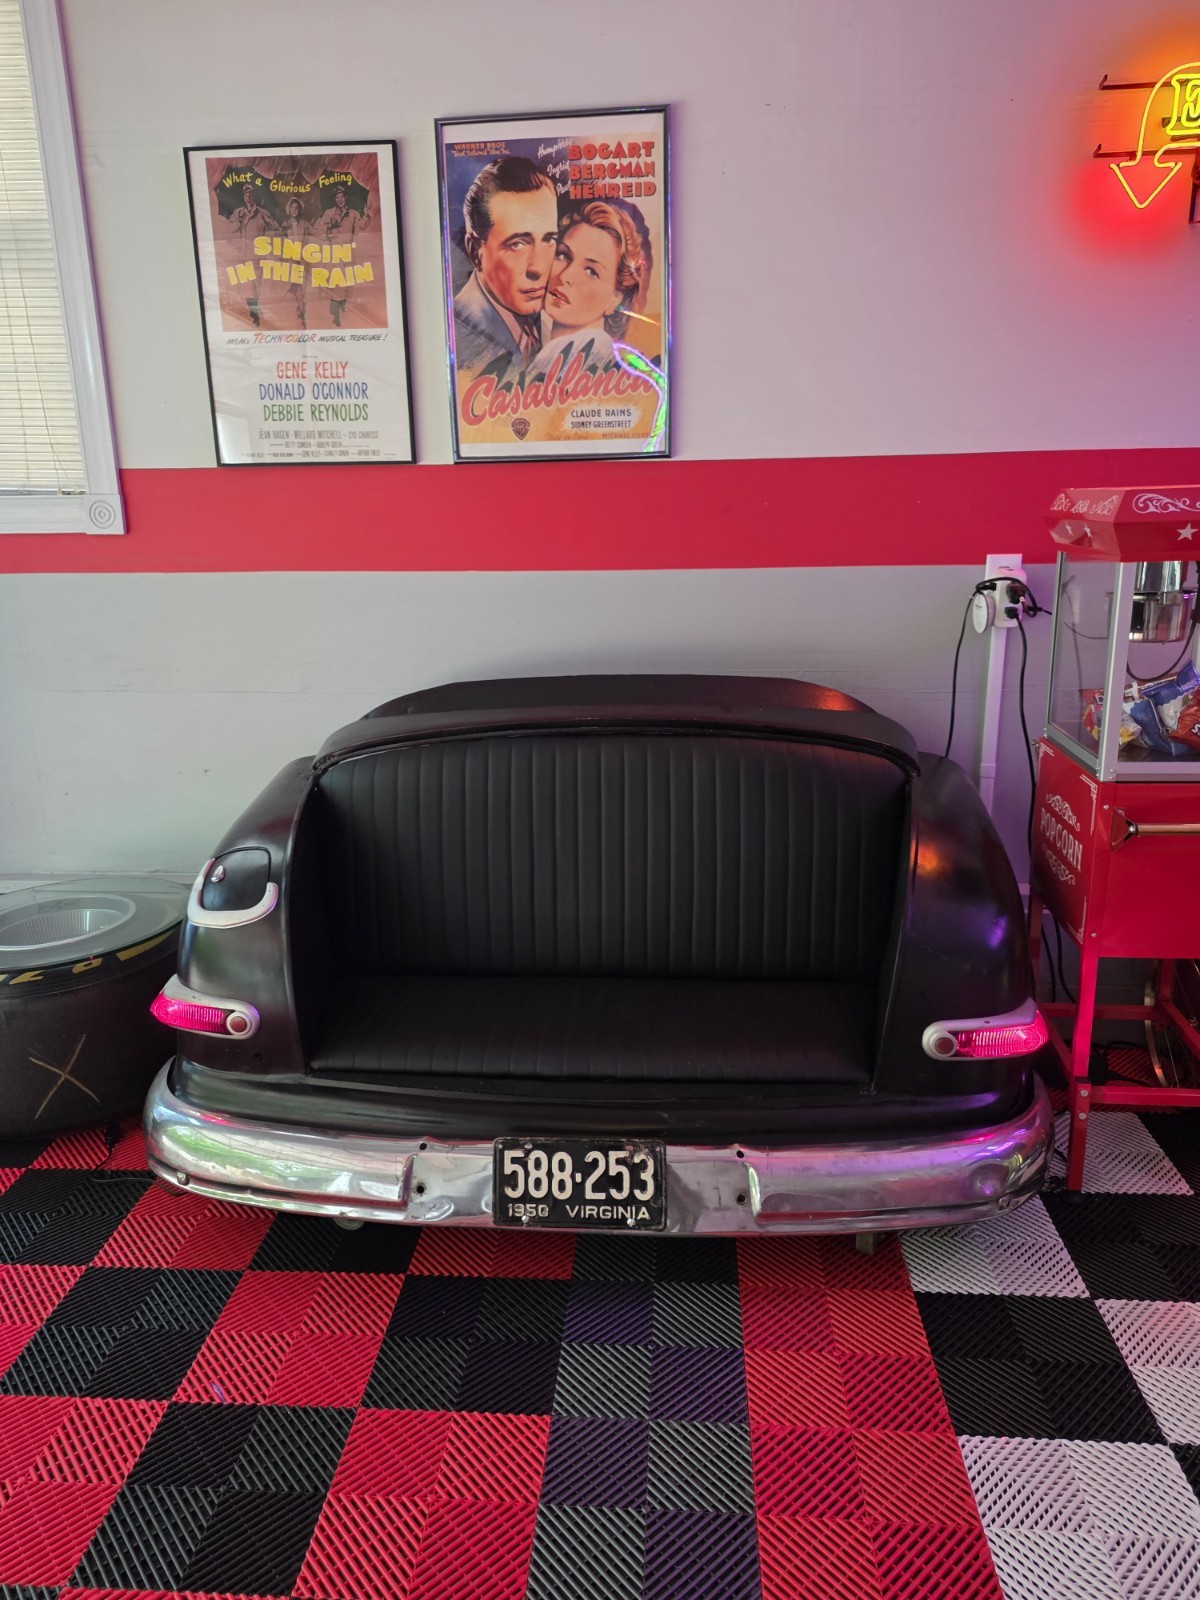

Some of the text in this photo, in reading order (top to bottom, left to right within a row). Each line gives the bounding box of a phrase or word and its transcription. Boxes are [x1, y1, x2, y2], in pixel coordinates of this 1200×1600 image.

[453, 143, 485, 151] WARNER
[567, 141, 655, 161] BOGART
[547, 160, 570, 179] Ingrid
[568, 160, 656, 181] BERGMAN
[222, 172, 353, 193] What a Glorious Feeling
[569, 181, 657, 200] HENREID
[253, 236, 357, 264] SINGIN'
[226, 260, 374, 289] IN THE RAIN
[253, 333, 317, 344] TECHNICOLOR
[318, 334, 347, 343] MUSICAL
[276, 360, 349, 380] GENE KELLY
[259, 382, 369, 401] DONALD O'CONNOR
[461, 351, 655, 427] Casablanca
[263, 403, 369, 422] DEBBIE REYNOLDS
[571, 408, 632, 418] CLAUDE RAINS
[593, 420, 631, 429] GREENSTREET
[1040, 807, 1083, 873] POPCORN
[507, 1203, 651, 1221] 1950 VIRGINIA
